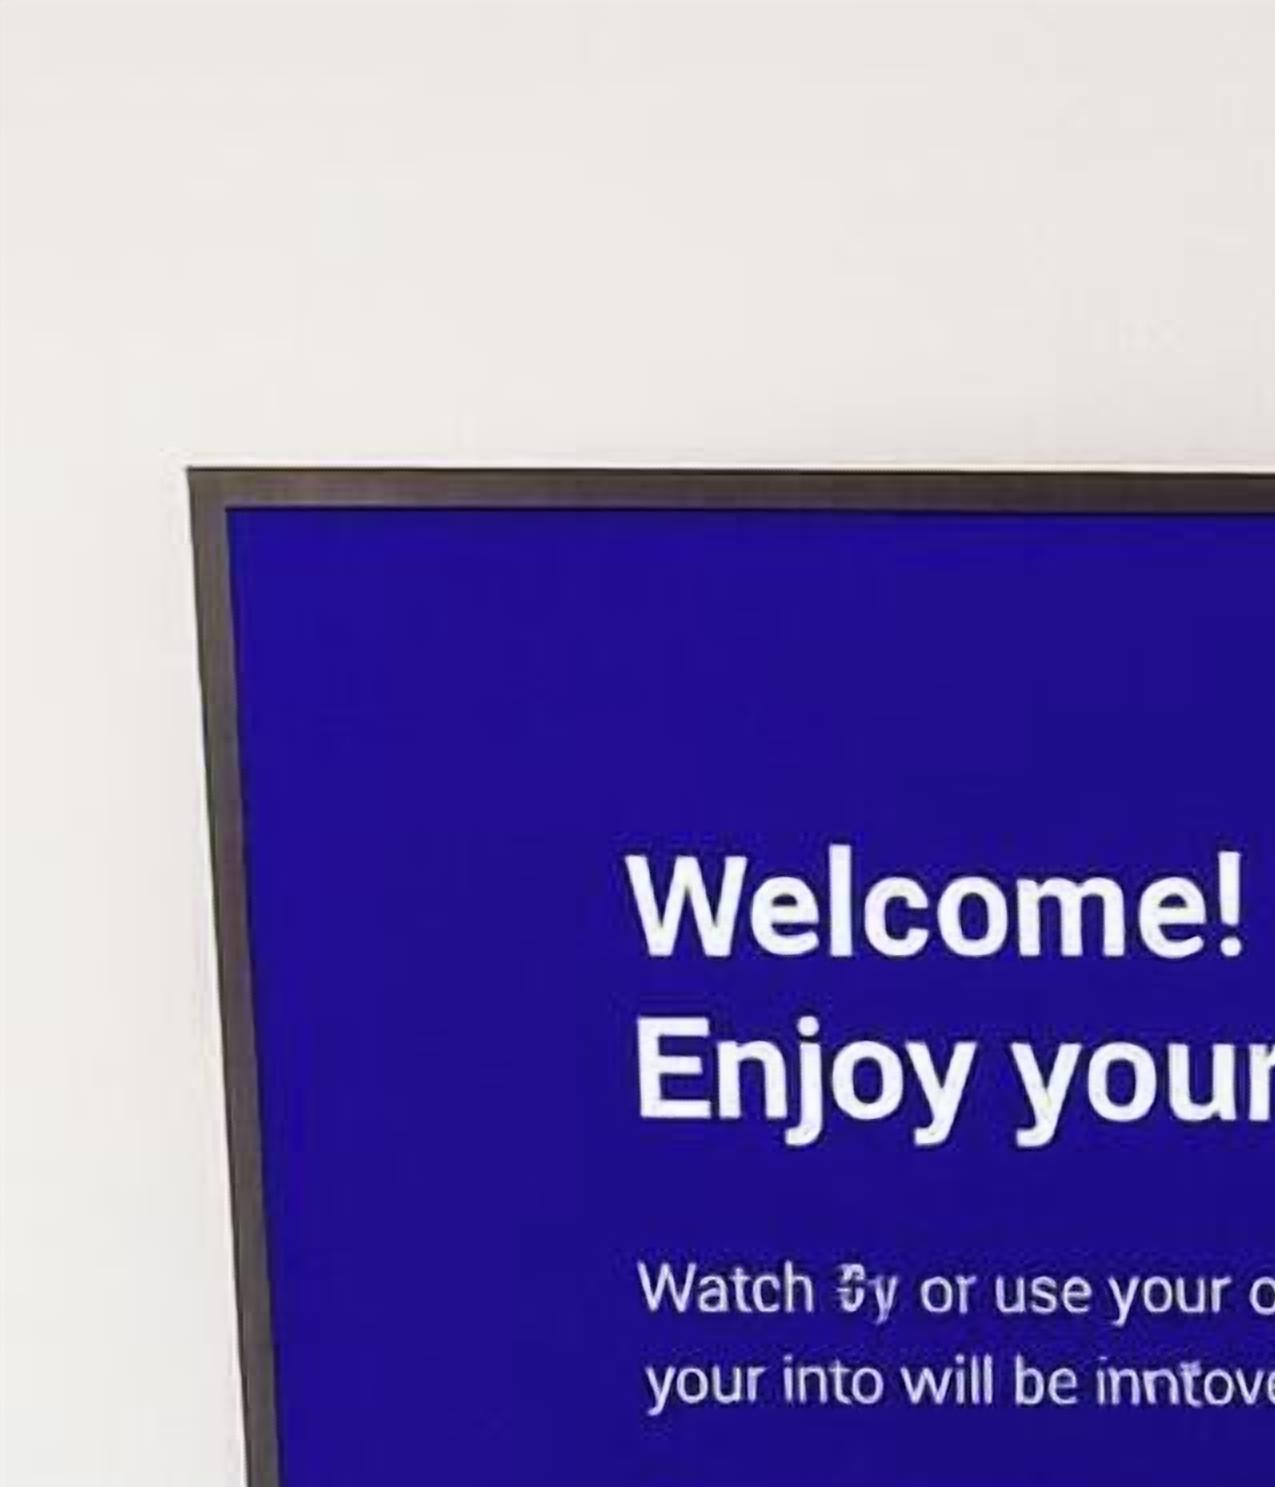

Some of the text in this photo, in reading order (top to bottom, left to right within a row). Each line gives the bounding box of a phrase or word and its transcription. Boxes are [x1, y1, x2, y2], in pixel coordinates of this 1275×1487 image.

[625, 844, 1244, 959] Welcome!
[636, 1014, 978, 1147] Enjoy
[637, 1260, 814, 1313] Watch
[920, 1274, 977, 1314] or
[995, 1275, 1093, 1315] use
[1107, 1275, 1233, 1327] your
[645, 1364, 767, 1417] your
[900, 1353, 994, 1405] will
[1014, 1353, 1078, 1406] be
